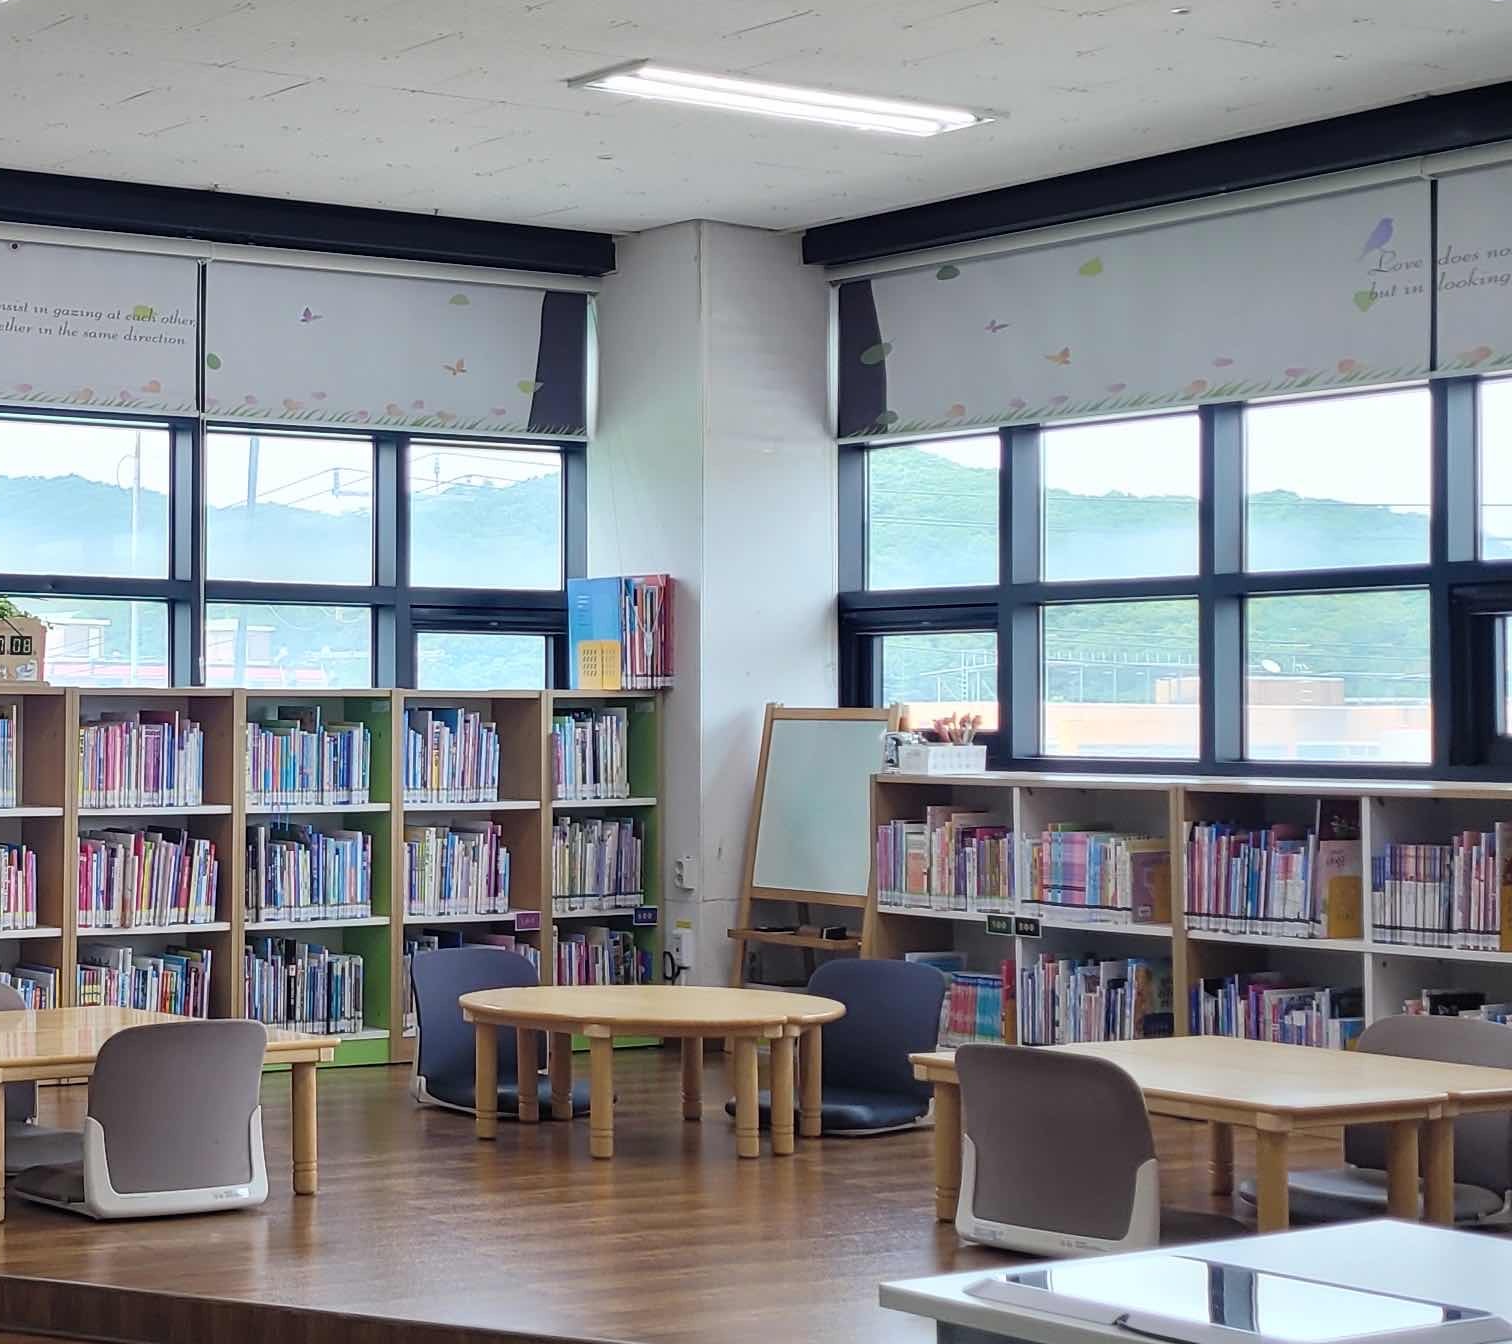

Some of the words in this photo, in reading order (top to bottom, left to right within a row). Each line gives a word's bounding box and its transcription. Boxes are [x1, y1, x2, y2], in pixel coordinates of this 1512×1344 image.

[1368, 250, 1424, 276] Love
[1438, 245, 1479, 267] does
[1487, 246, 1512, 260] no
[1369, 280, 1397, 302] but
[1404, 283, 1424, 295] in
[1438, 266, 1512, 292] looking
[34, 304, 49, 315] in
[54, 306, 103, 322] gazing
[107, 309, 122, 321] at
[125, 307, 158, 324] each
[38, 326, 53, 336] in
[58, 320, 78, 337] the
[83, 329, 119, 341] same
[12, 637, 31, 653] 08
